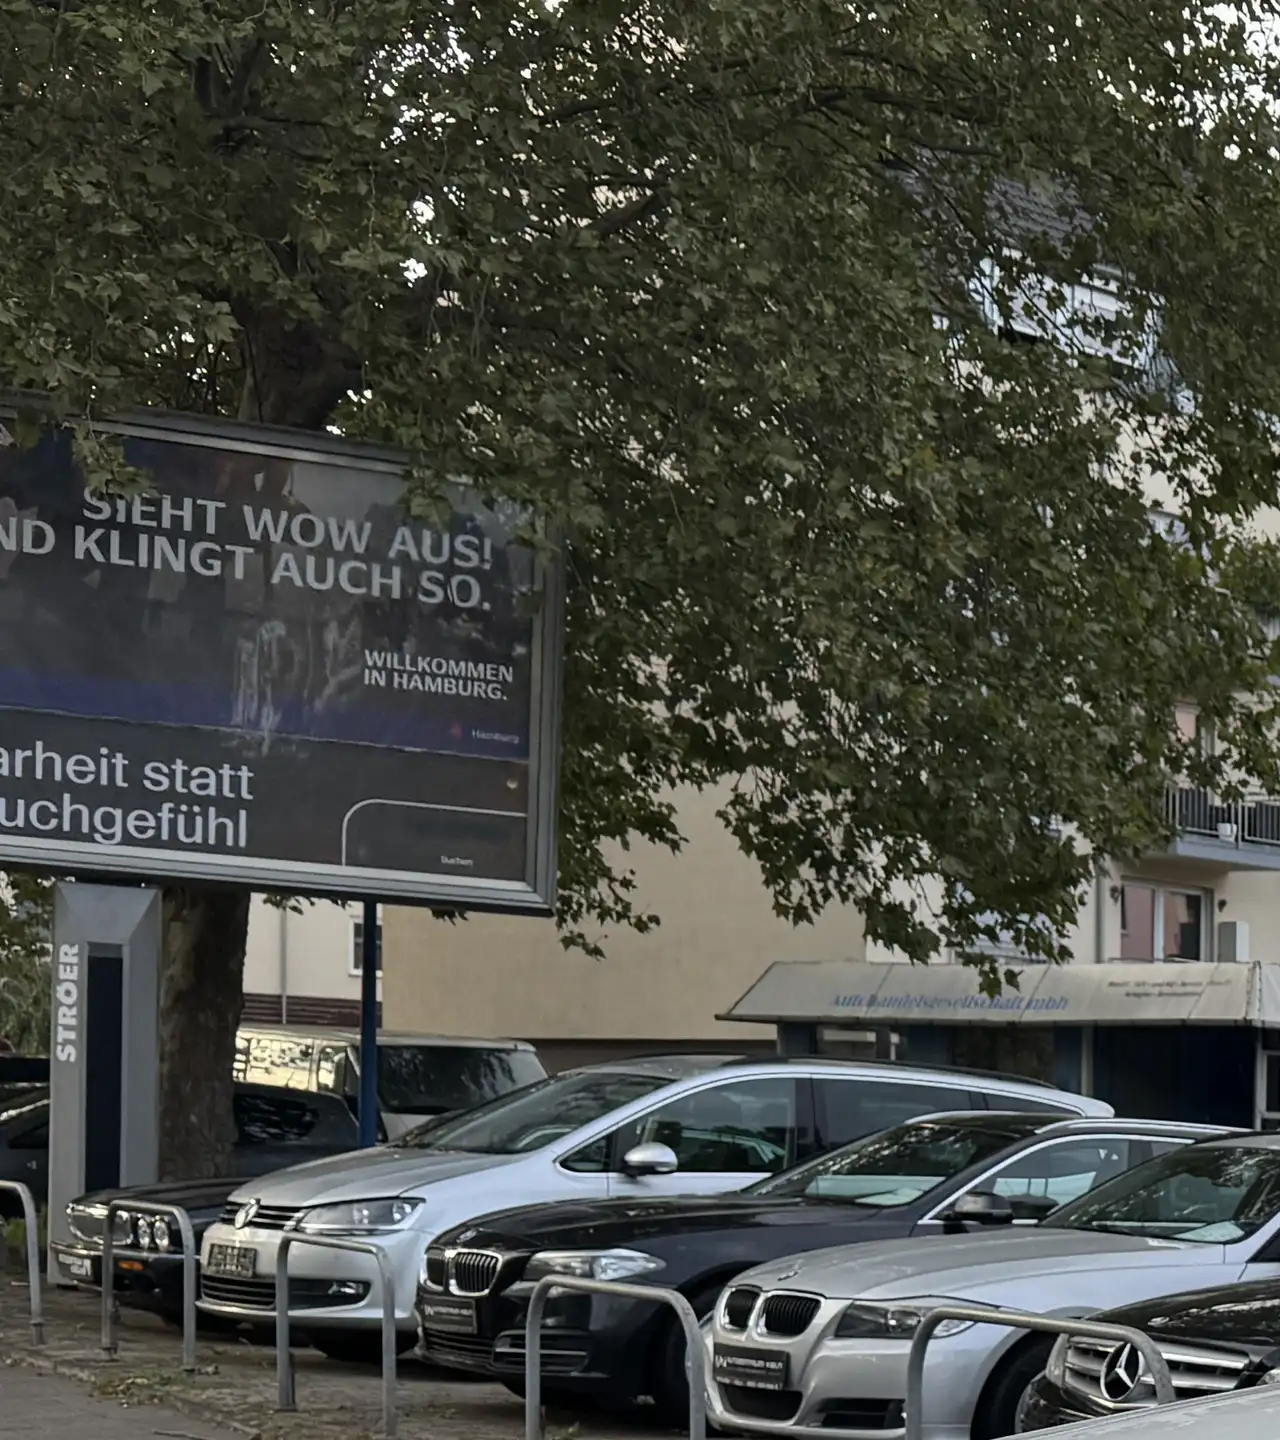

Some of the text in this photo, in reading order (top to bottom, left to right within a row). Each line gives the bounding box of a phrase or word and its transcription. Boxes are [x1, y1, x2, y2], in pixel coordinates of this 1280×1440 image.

[82, 490, 494, 571] SIEHT WOW AUS!
[73, 527, 254, 580] KLINGT
[270, 552, 402, 600] AUCH
[417, 569, 492, 611] SO.
[364, 649, 513, 683] WILLKOMMEN
[364, 668, 508, 701] IN HAMBURG.
[142, 757, 255, 801] statt
[55, 942, 80, 1063] STRÖER
